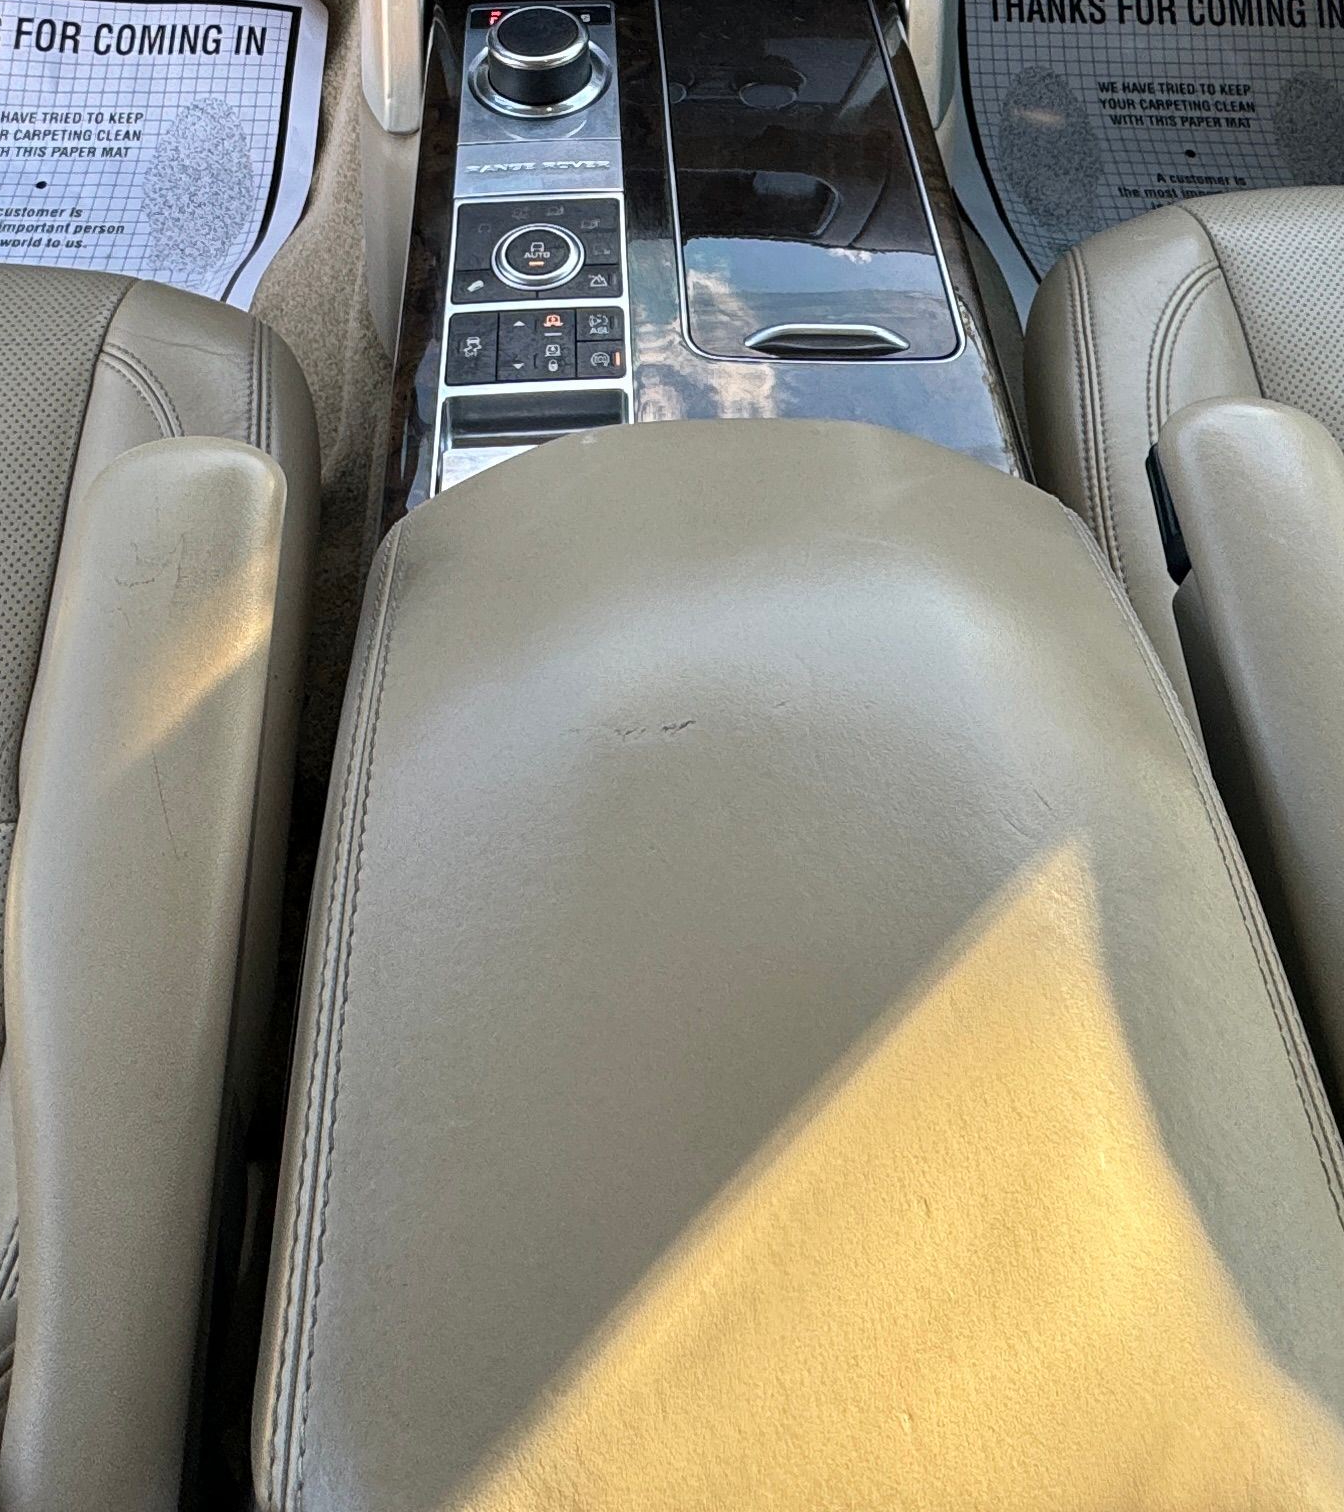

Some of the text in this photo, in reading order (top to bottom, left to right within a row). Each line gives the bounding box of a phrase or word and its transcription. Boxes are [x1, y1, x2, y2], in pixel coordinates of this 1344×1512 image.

[14, 17, 82, 55] FOR
[94, 23, 222, 56] COMING
[234, 26, 267, 57] IN
[1098, 82, 1251, 96] WE HAVE TRIED TO KEEP
[1099, 98, 1256, 113] YOUR CARPETING CLEAN
[1, 111, 38, 124] HAVE
[42, 112, 83, 125] TRIED
[87, 112, 104, 125] TO
[108, 112, 144, 125] KEEP
[1110, 114, 1251, 129] WITH THIS PAPER MAT
[13, 129, 92, 142] CARPETING
[97, 129, 142, 142] CLEAN
[16, 146, 47, 158] THIS
[51, 146, 96, 158] PAPER
[101, 147, 131, 158] MAT
[541, 160, 610, 170] ROVER
[1157, 173, 1247, 186] A customer is
[1118, 187, 1141, 199] the
[1144, 188, 1179, 199] most
[69, 207, 84, 218] is
[73, 224, 125, 235] person
[0, 236, 42, 248] world
[45, 237, 61, 248] to
[65, 239, 87, 249] us.
[523, 251, 551, 259] AUTO
